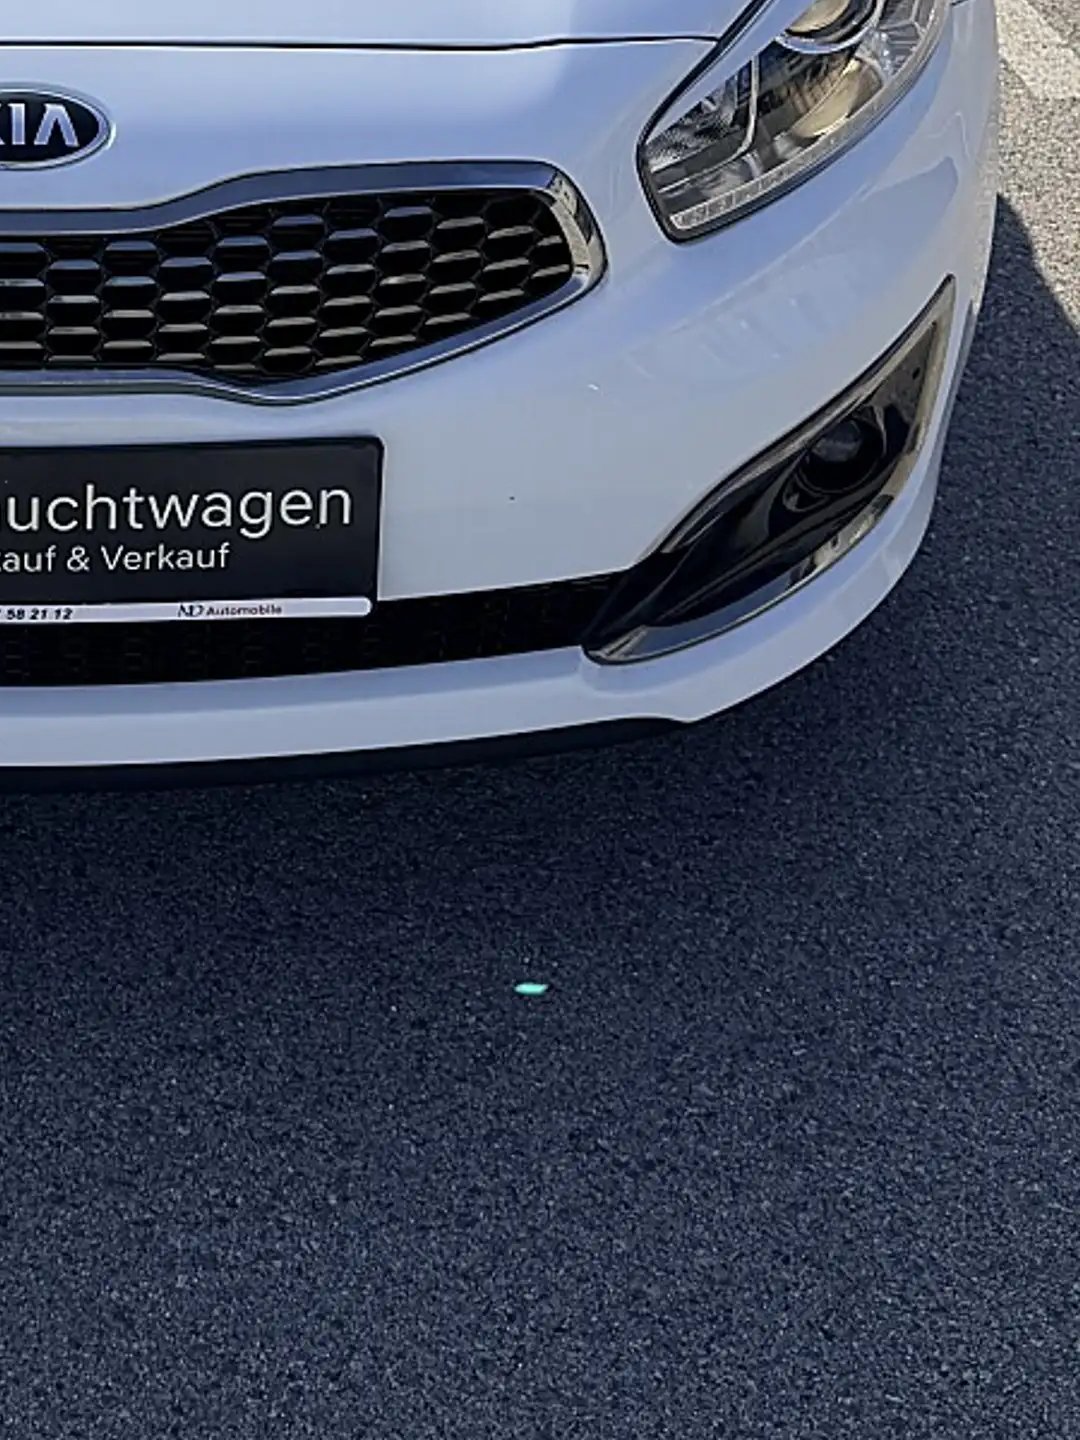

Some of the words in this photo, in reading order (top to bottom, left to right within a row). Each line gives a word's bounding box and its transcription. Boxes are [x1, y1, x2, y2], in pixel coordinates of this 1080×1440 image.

[66, 545, 91, 573] &
[101, 542, 231, 572] Verkauf
[6, 608, 25, 620] 58
[30, 607, 48, 620] 21
[54, 607, 73, 620] 12
[206, 604, 282, 616] Automobile
